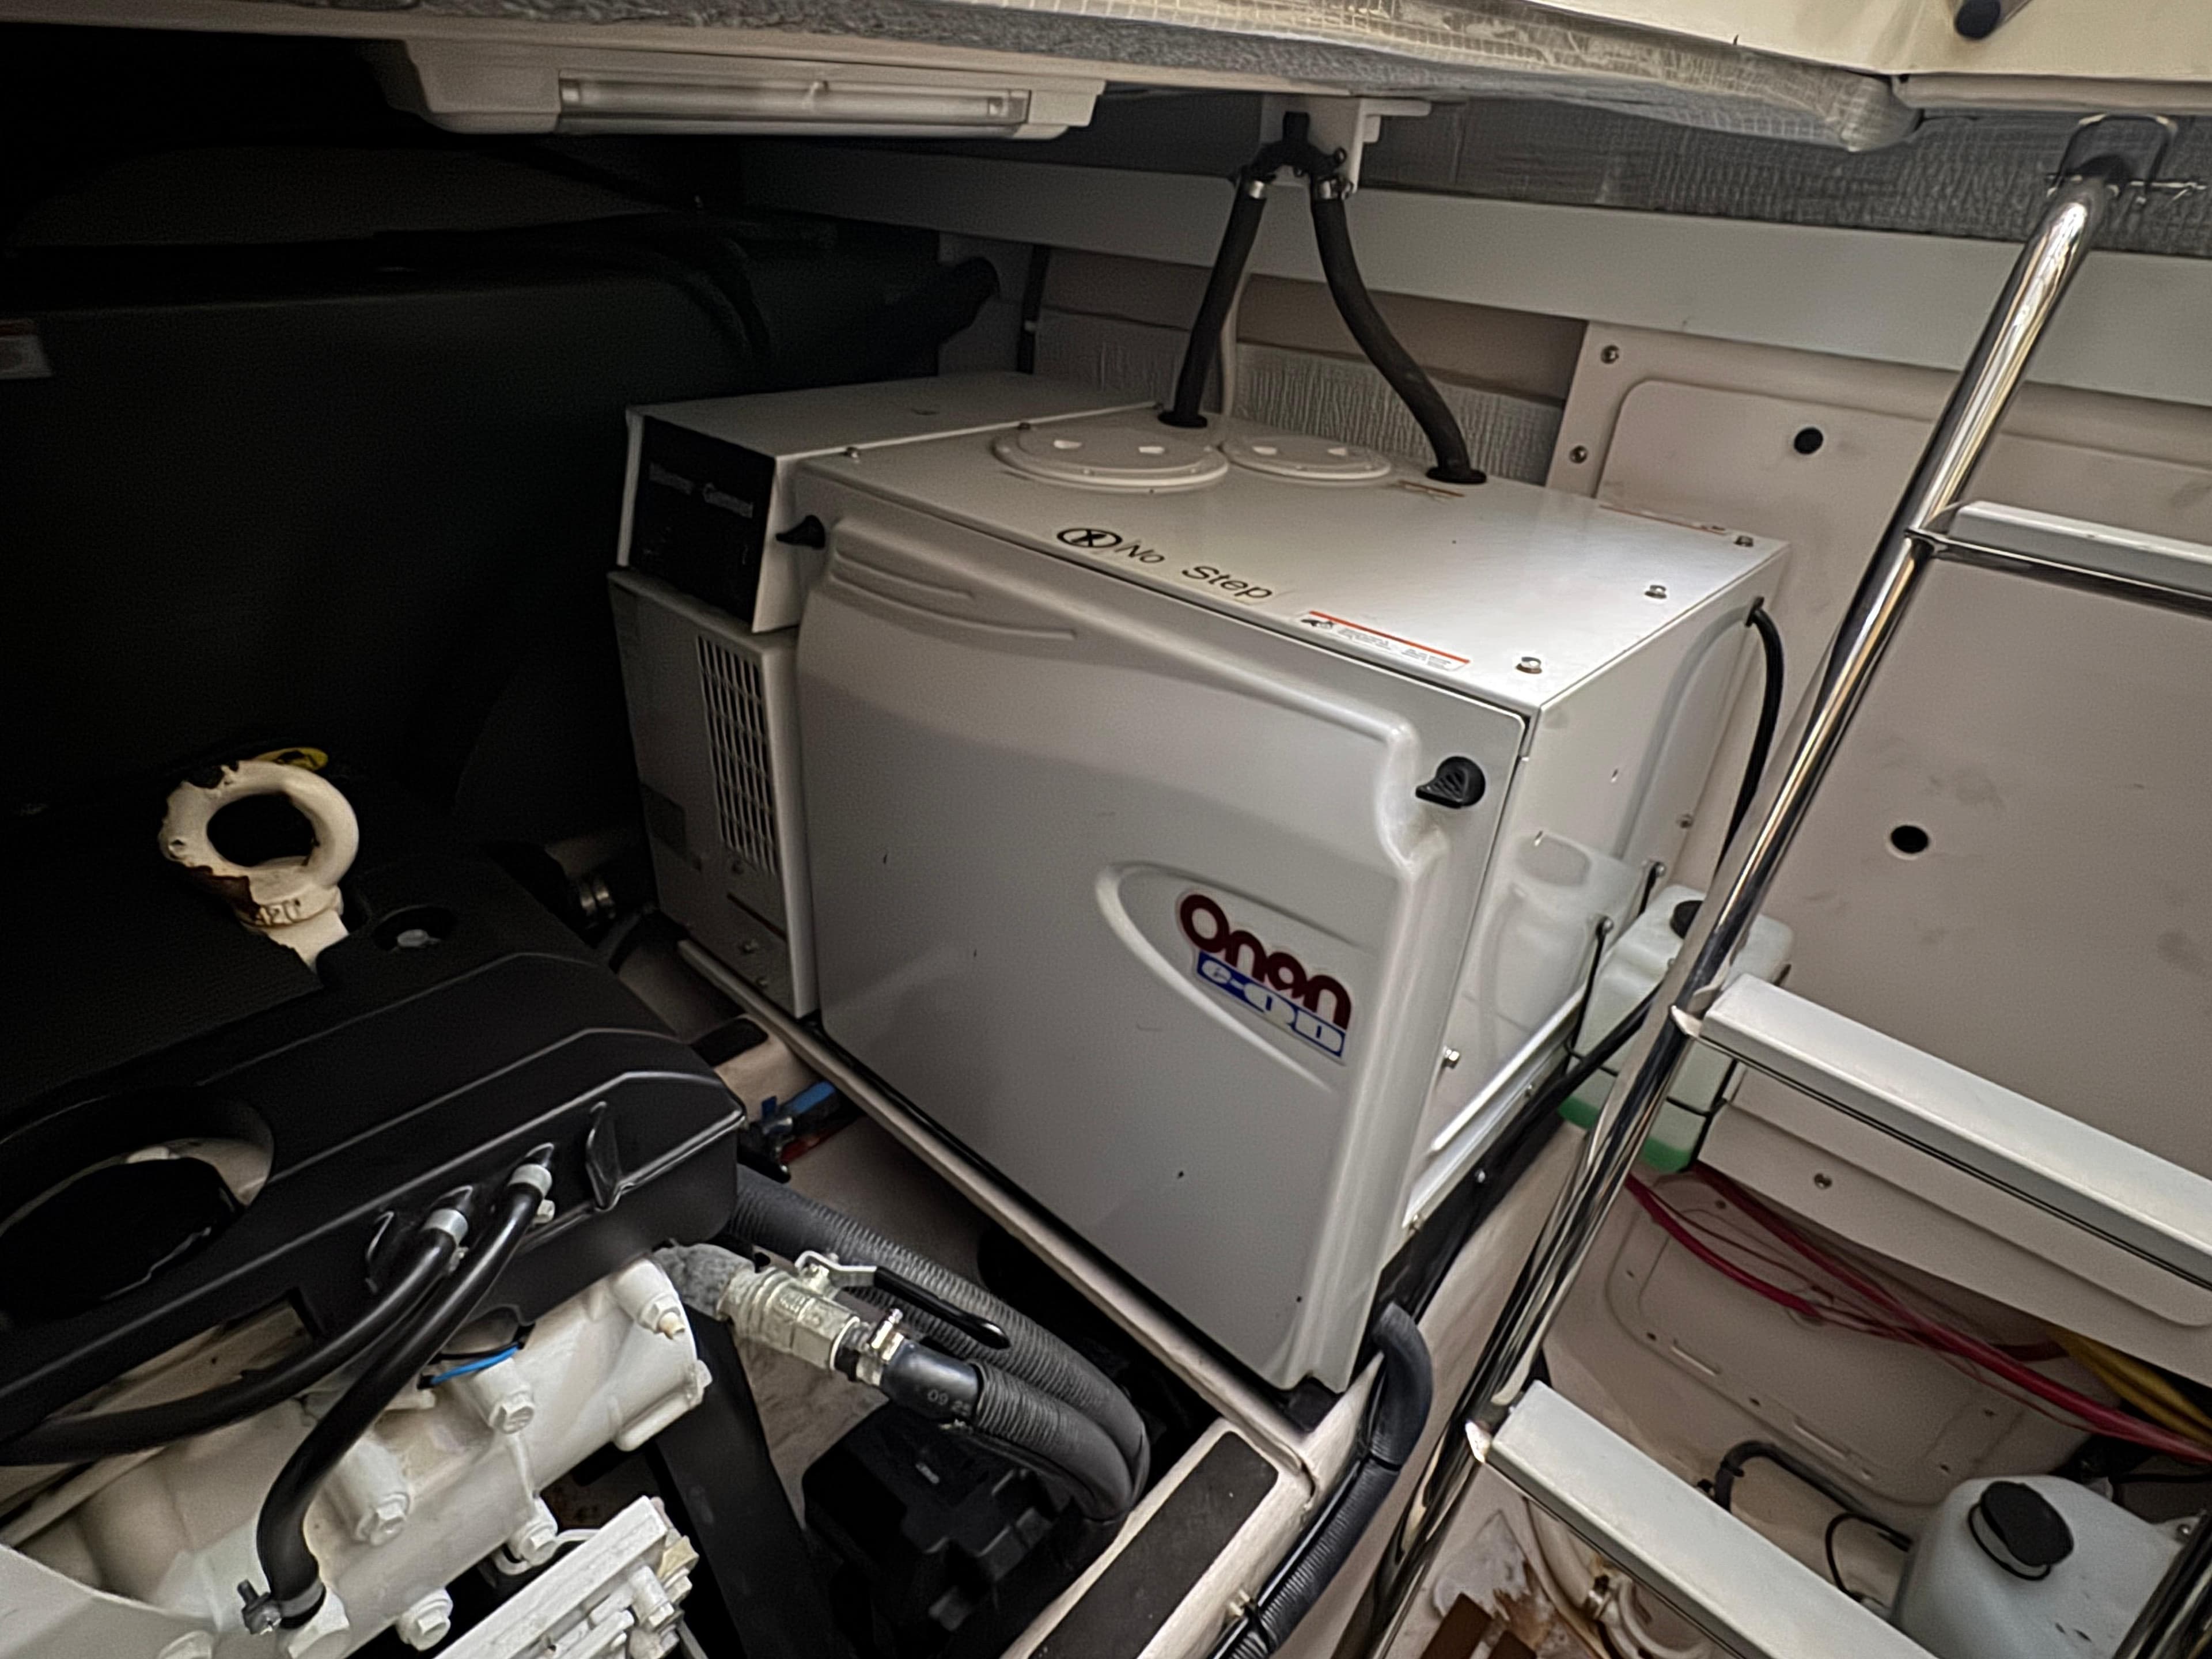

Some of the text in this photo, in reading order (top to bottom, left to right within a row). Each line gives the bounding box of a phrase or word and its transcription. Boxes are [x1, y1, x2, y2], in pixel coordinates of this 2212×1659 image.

[1114, 544, 1272, 599] No Step
[1180, 893, 1351, 1031] Onan
